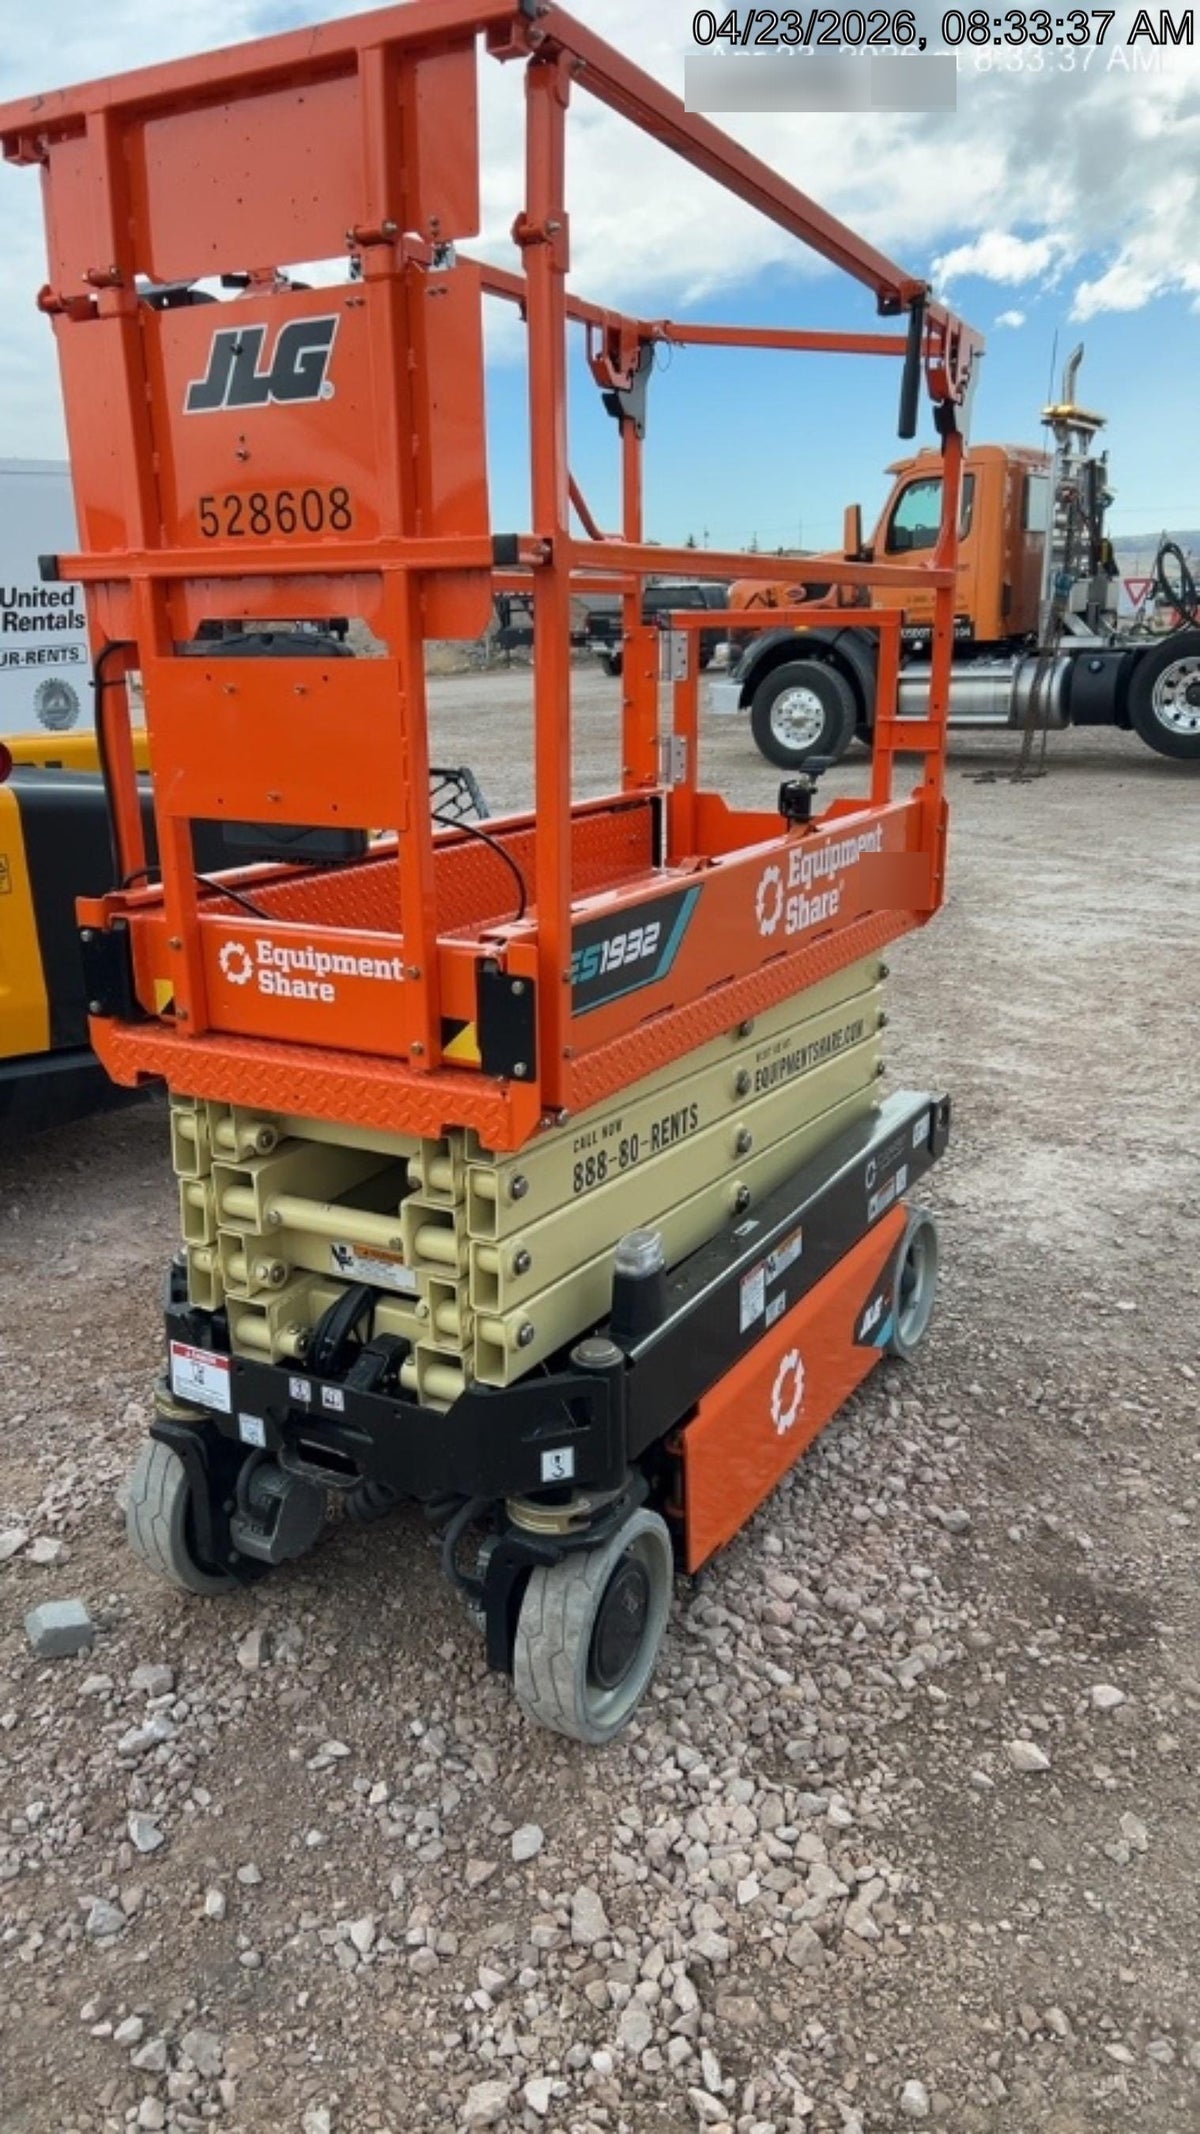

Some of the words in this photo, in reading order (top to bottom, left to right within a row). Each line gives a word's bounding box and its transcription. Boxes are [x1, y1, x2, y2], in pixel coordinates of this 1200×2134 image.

[182, 313, 341, 416] JLG
[200, 487, 352, 538] 528608
[0, 585, 75, 608] United
[2, 609, 86, 632] Rentals
[786, 823, 883, 890] Equipment
[785, 888, 840, 935] Share
[256, 939, 405, 982] Equipment
[257, 969, 335, 1003] Share
[573, 1133, 598, 1153] CALL
[602, 1118, 623, 1138] NOW
[573, 1102, 699, 1193] 888-80-RENTS
